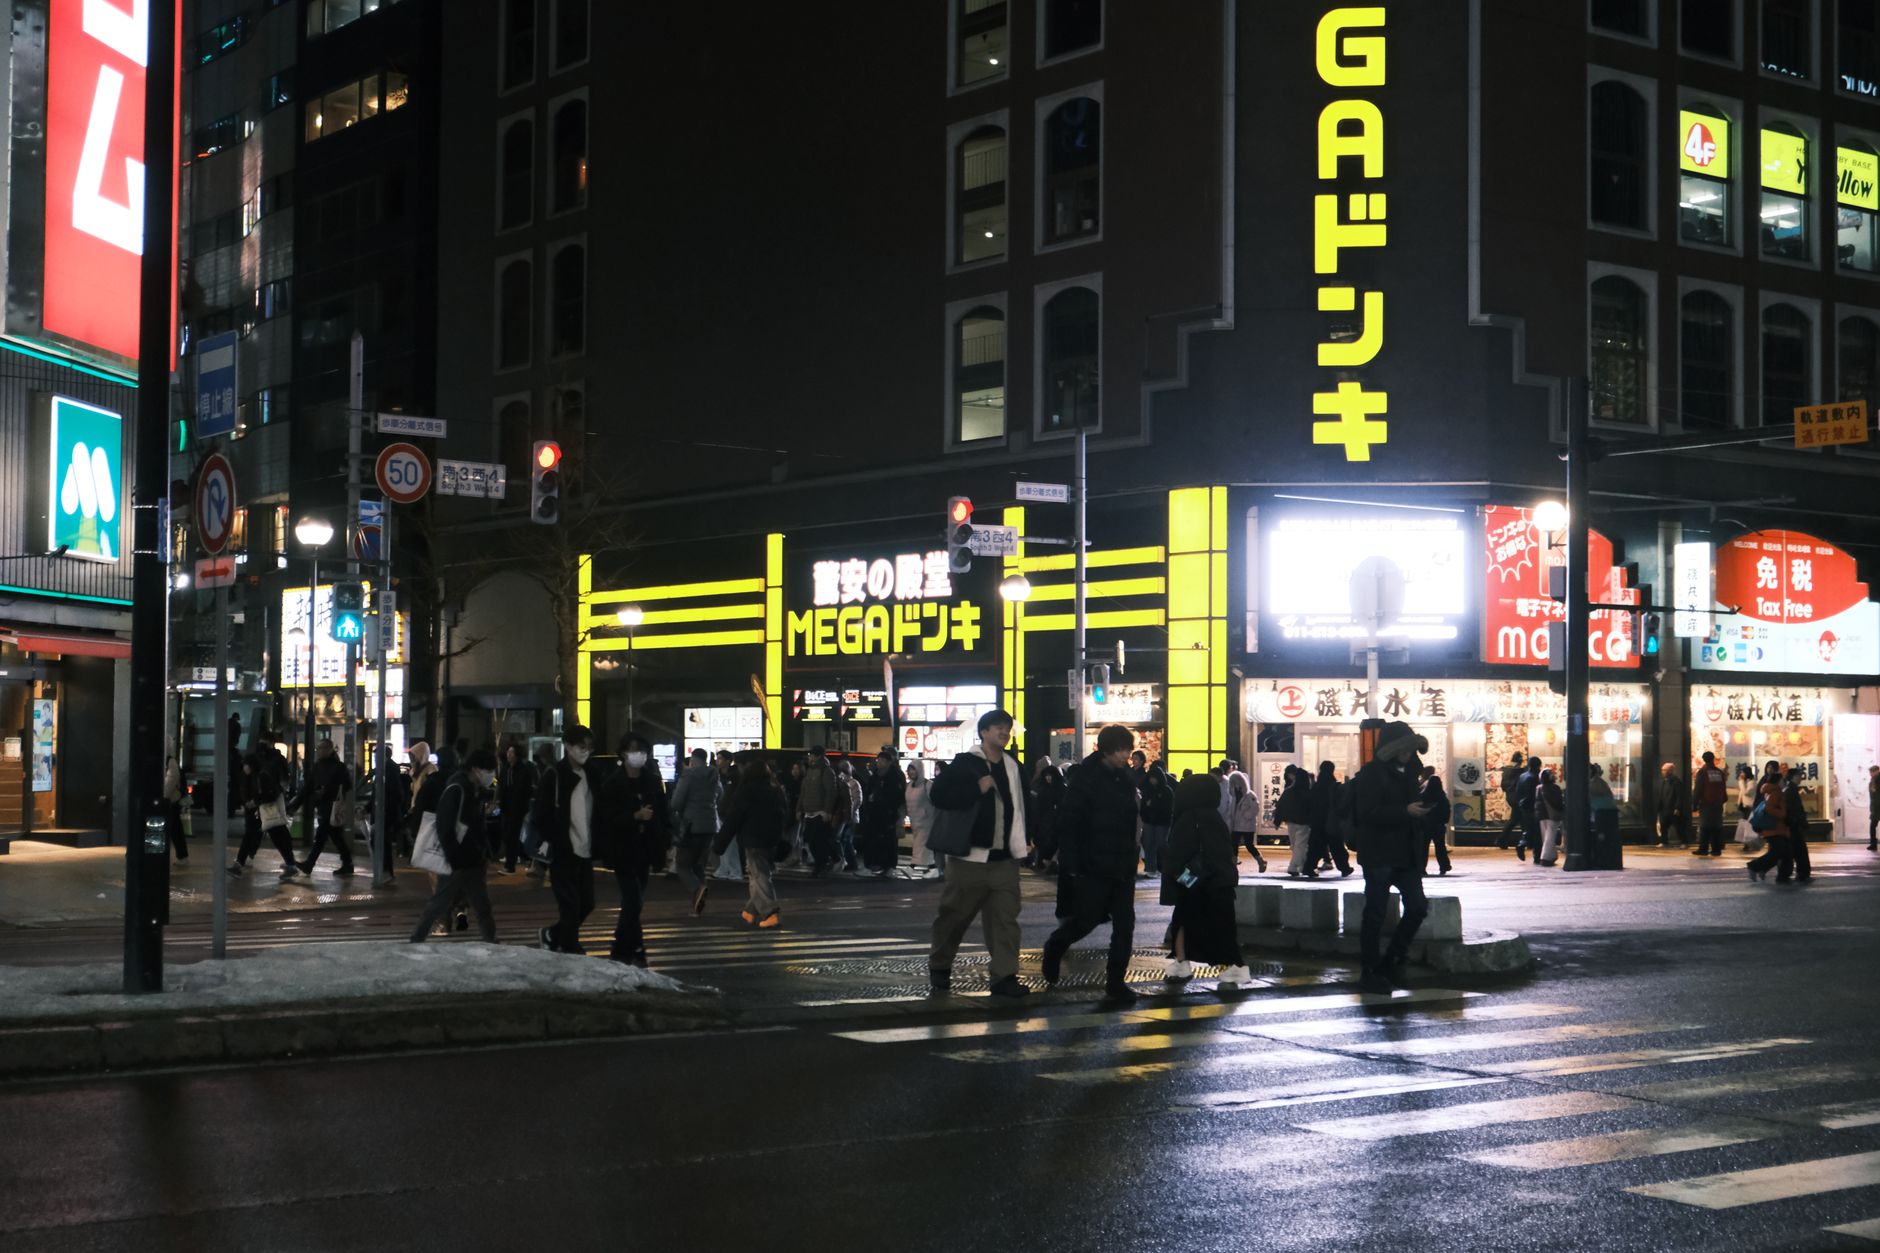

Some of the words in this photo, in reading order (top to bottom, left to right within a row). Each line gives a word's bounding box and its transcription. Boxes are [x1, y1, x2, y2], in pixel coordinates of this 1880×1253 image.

[1685, 123, 1716, 165] 4F
[1852, 159, 1872, 170] BASE
[1313, 7, 1387, 461] GAドンキ
[200, 387, 233, 421] 停止線
[1801, 405, 1860, 424] 軌道敷内
[382, 419, 442, 432] 歩車分離式信号
[1802, 424, 1861, 443] 通行禁止
[389, 459, 418, 486] 50
[1756, 556, 1812, 591] 免税
[1756, 597, 1781, 616] Tax
[1784, 599, 1813, 618] Free
[788, 601, 981, 656] MEGAドンキ
[1498, 626, 1628, 662] maca
[1315, 687, 1447, 717] 磯丸水産
[1727, 693, 1803, 721] 磯丸水産
